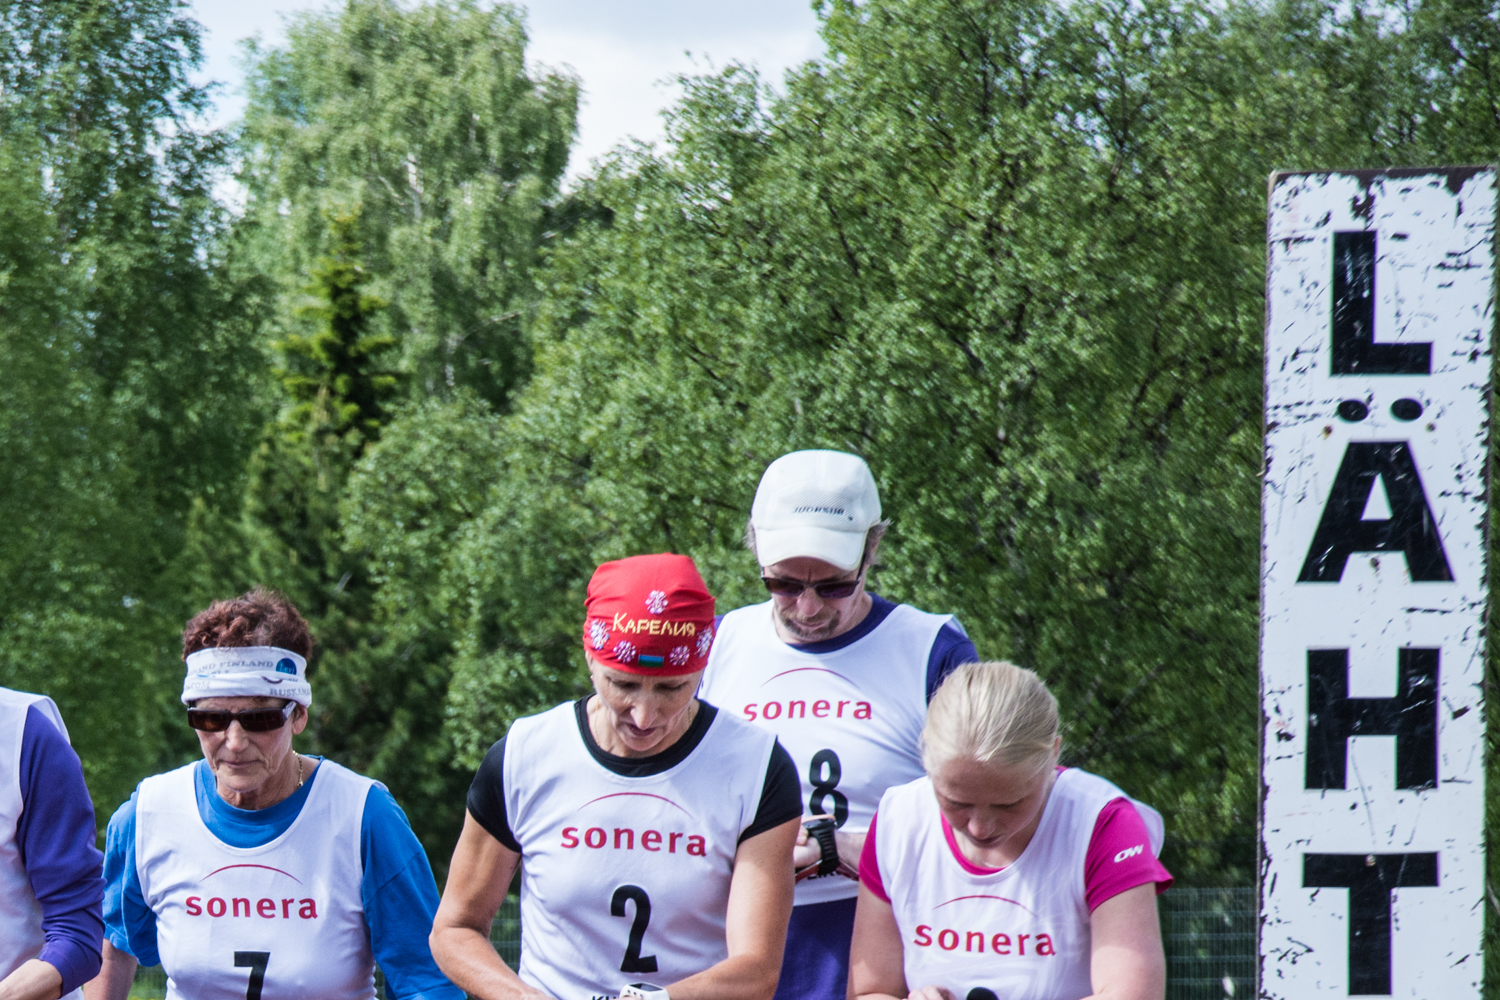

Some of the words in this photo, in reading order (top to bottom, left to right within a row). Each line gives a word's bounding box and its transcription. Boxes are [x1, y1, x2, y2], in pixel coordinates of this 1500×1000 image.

[743, 699, 872, 722] sonera
[560, 826, 707, 857] sonera
[185, 896, 318, 919] sonera
[610, 885, 658, 973] 2
[913, 924, 1056, 957] sonera
